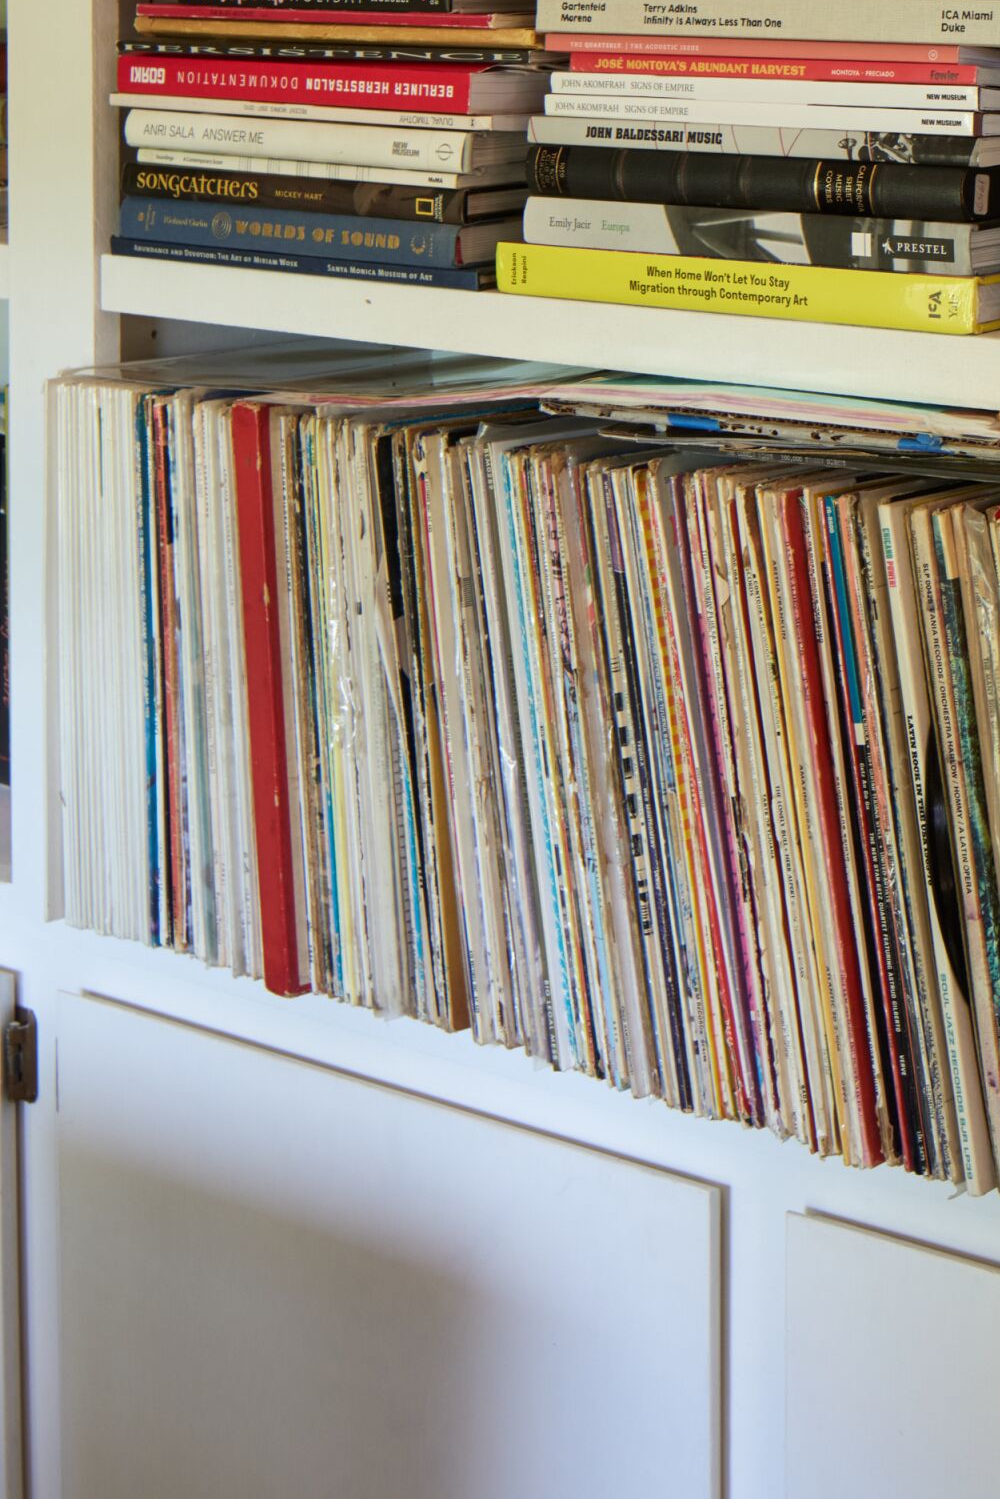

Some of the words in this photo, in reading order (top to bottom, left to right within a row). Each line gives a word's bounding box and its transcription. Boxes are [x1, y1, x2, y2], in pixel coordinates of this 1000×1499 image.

[643, 3, 667, 14] Terry
[668, 4, 697, 14] Adkins
[941, 10, 959, 20] ICA
[962, 11, 993, 21] Miami
[643, 15, 673, 26] Infinity
[685, 16, 717, 27] Always
[719, 18, 738, 27] Less
[741, 18, 762, 27] Than
[764, 19, 782, 28] One
[941, 23, 966, 33] Duke
[594, 58, 624, 70] JOSÉ
[626, 59, 686, 72] MONTOYA'S
[689, 61, 749, 74] ABUNDANT
[751, 64, 806, 76] HARVEST
[177, 70, 298, 90] DOKUMENTATION
[306, 77, 389, 94] HERBSTSALON
[561, 79, 580, 89] JOHN
[582, 79, 625, 90] AKOMFRAH
[630, 80, 652, 90] SIGNS
[665, 83, 695, 92] EMPIRE
[395, 82, 454, 98] BERLINER
[143, 123, 166, 137] ANRI
[168, 125, 195, 139] SALA
[202, 129, 246, 143] ANSWER
[248, 131, 264, 145] ME
[586, 126, 612, 139] JOHN
[615, 127, 683, 143] BALDESSARI
[687, 130, 723, 145] MUSIC
[549, 216, 573, 231] Emily
[573, 218, 592, 231] Jacir
[601, 220, 630, 234] Europa
[235, 220, 306, 242] WORLDS
[312, 226, 334, 244] OF
[341, 230, 400, 249] SOUND
[896, 242, 947, 255] PRESTEL
[646, 265, 672, 279] When
[674, 268, 702, 281] Home
[703, 270, 731, 284] Won't
[733, 272, 748, 285] Let
[750, 274, 767, 287] You
[768, 275, 790, 290] Stay
[629, 280, 676, 296] Migration
[678, 284, 718, 300] through
[719, 287, 791, 306] Contemporary
[793, 294, 808, 306] Art
[907, 714, 916, 750] LATIN
[911, 752, 921, 781] ROCK
[916, 784, 923, 796] IN
[918, 797, 926, 821] THE
